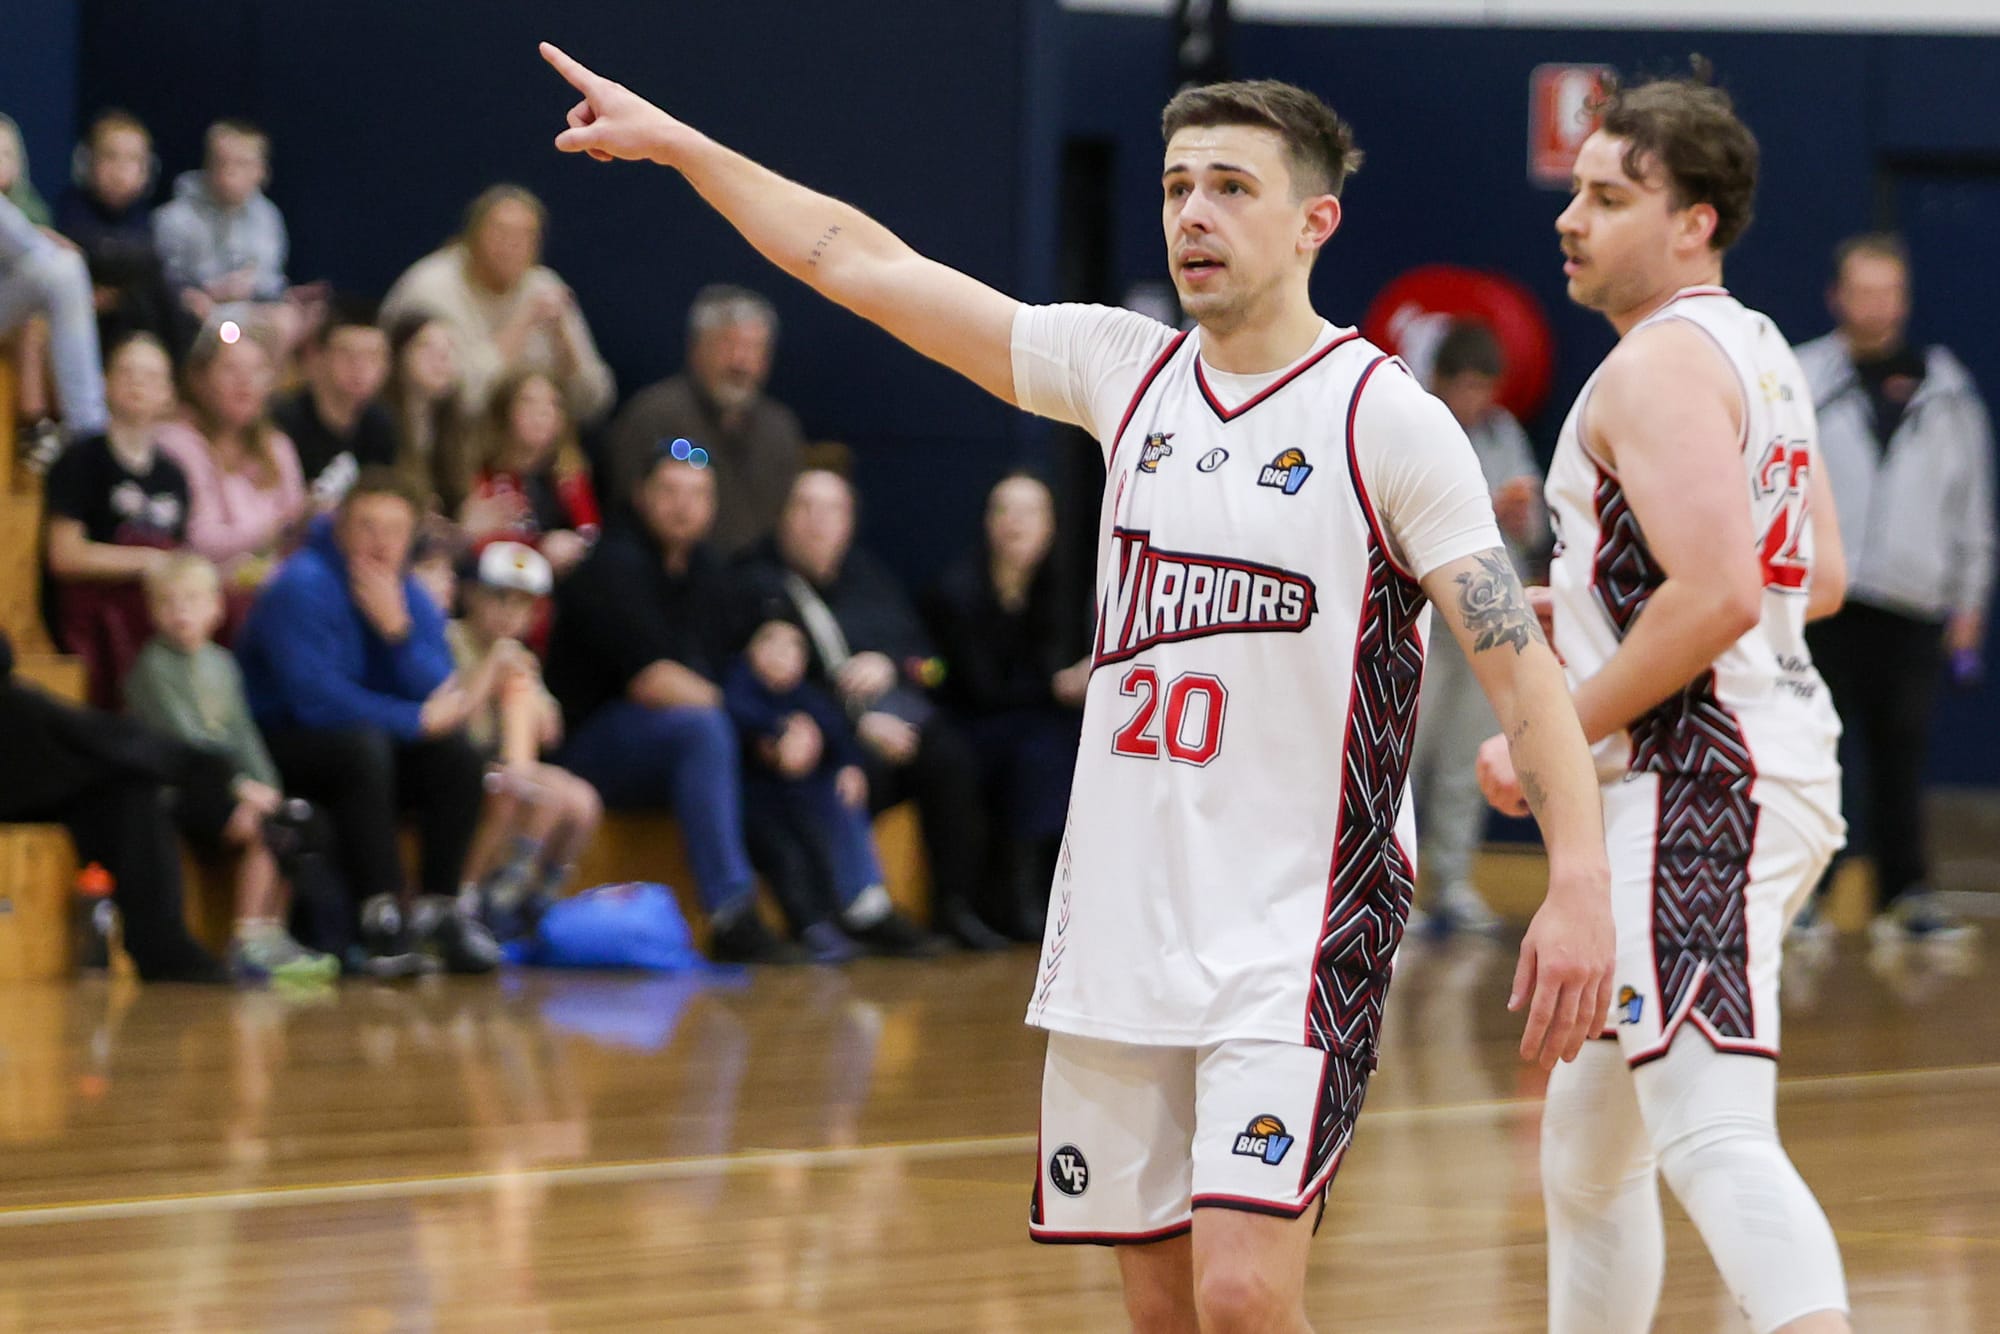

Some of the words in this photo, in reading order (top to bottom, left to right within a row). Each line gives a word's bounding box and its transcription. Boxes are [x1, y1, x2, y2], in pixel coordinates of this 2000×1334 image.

[1261, 467, 1289, 486] BIG
[1285, 466, 1309, 492] V
[1099, 533, 1305, 656] WARRIORS
[1111, 664, 1229, 768] 20
[1236, 1135, 1267, 1154] BIG
[1266, 1134, 1290, 1162] V
